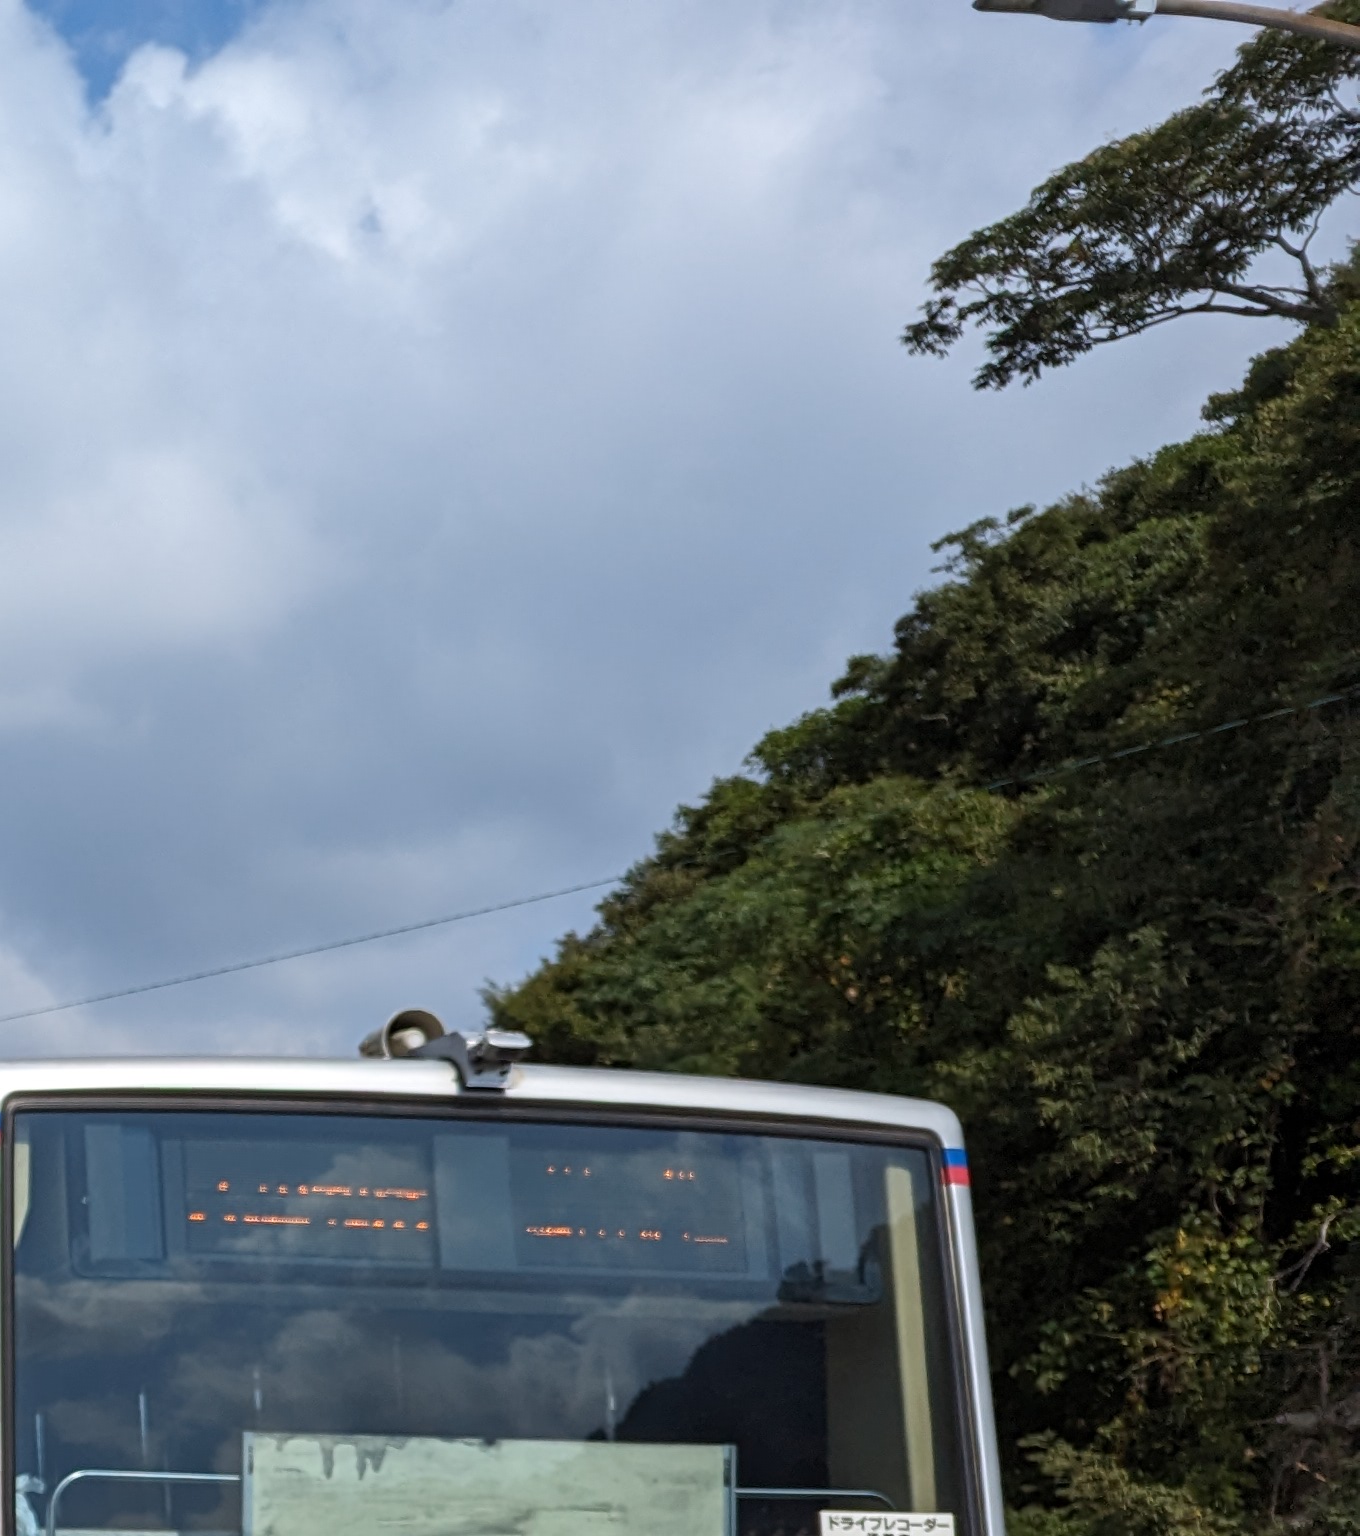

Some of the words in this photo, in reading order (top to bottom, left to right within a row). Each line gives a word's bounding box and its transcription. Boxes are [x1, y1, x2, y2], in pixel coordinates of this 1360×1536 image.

[828, 1515, 950, 1533] ドライブレコーダー
